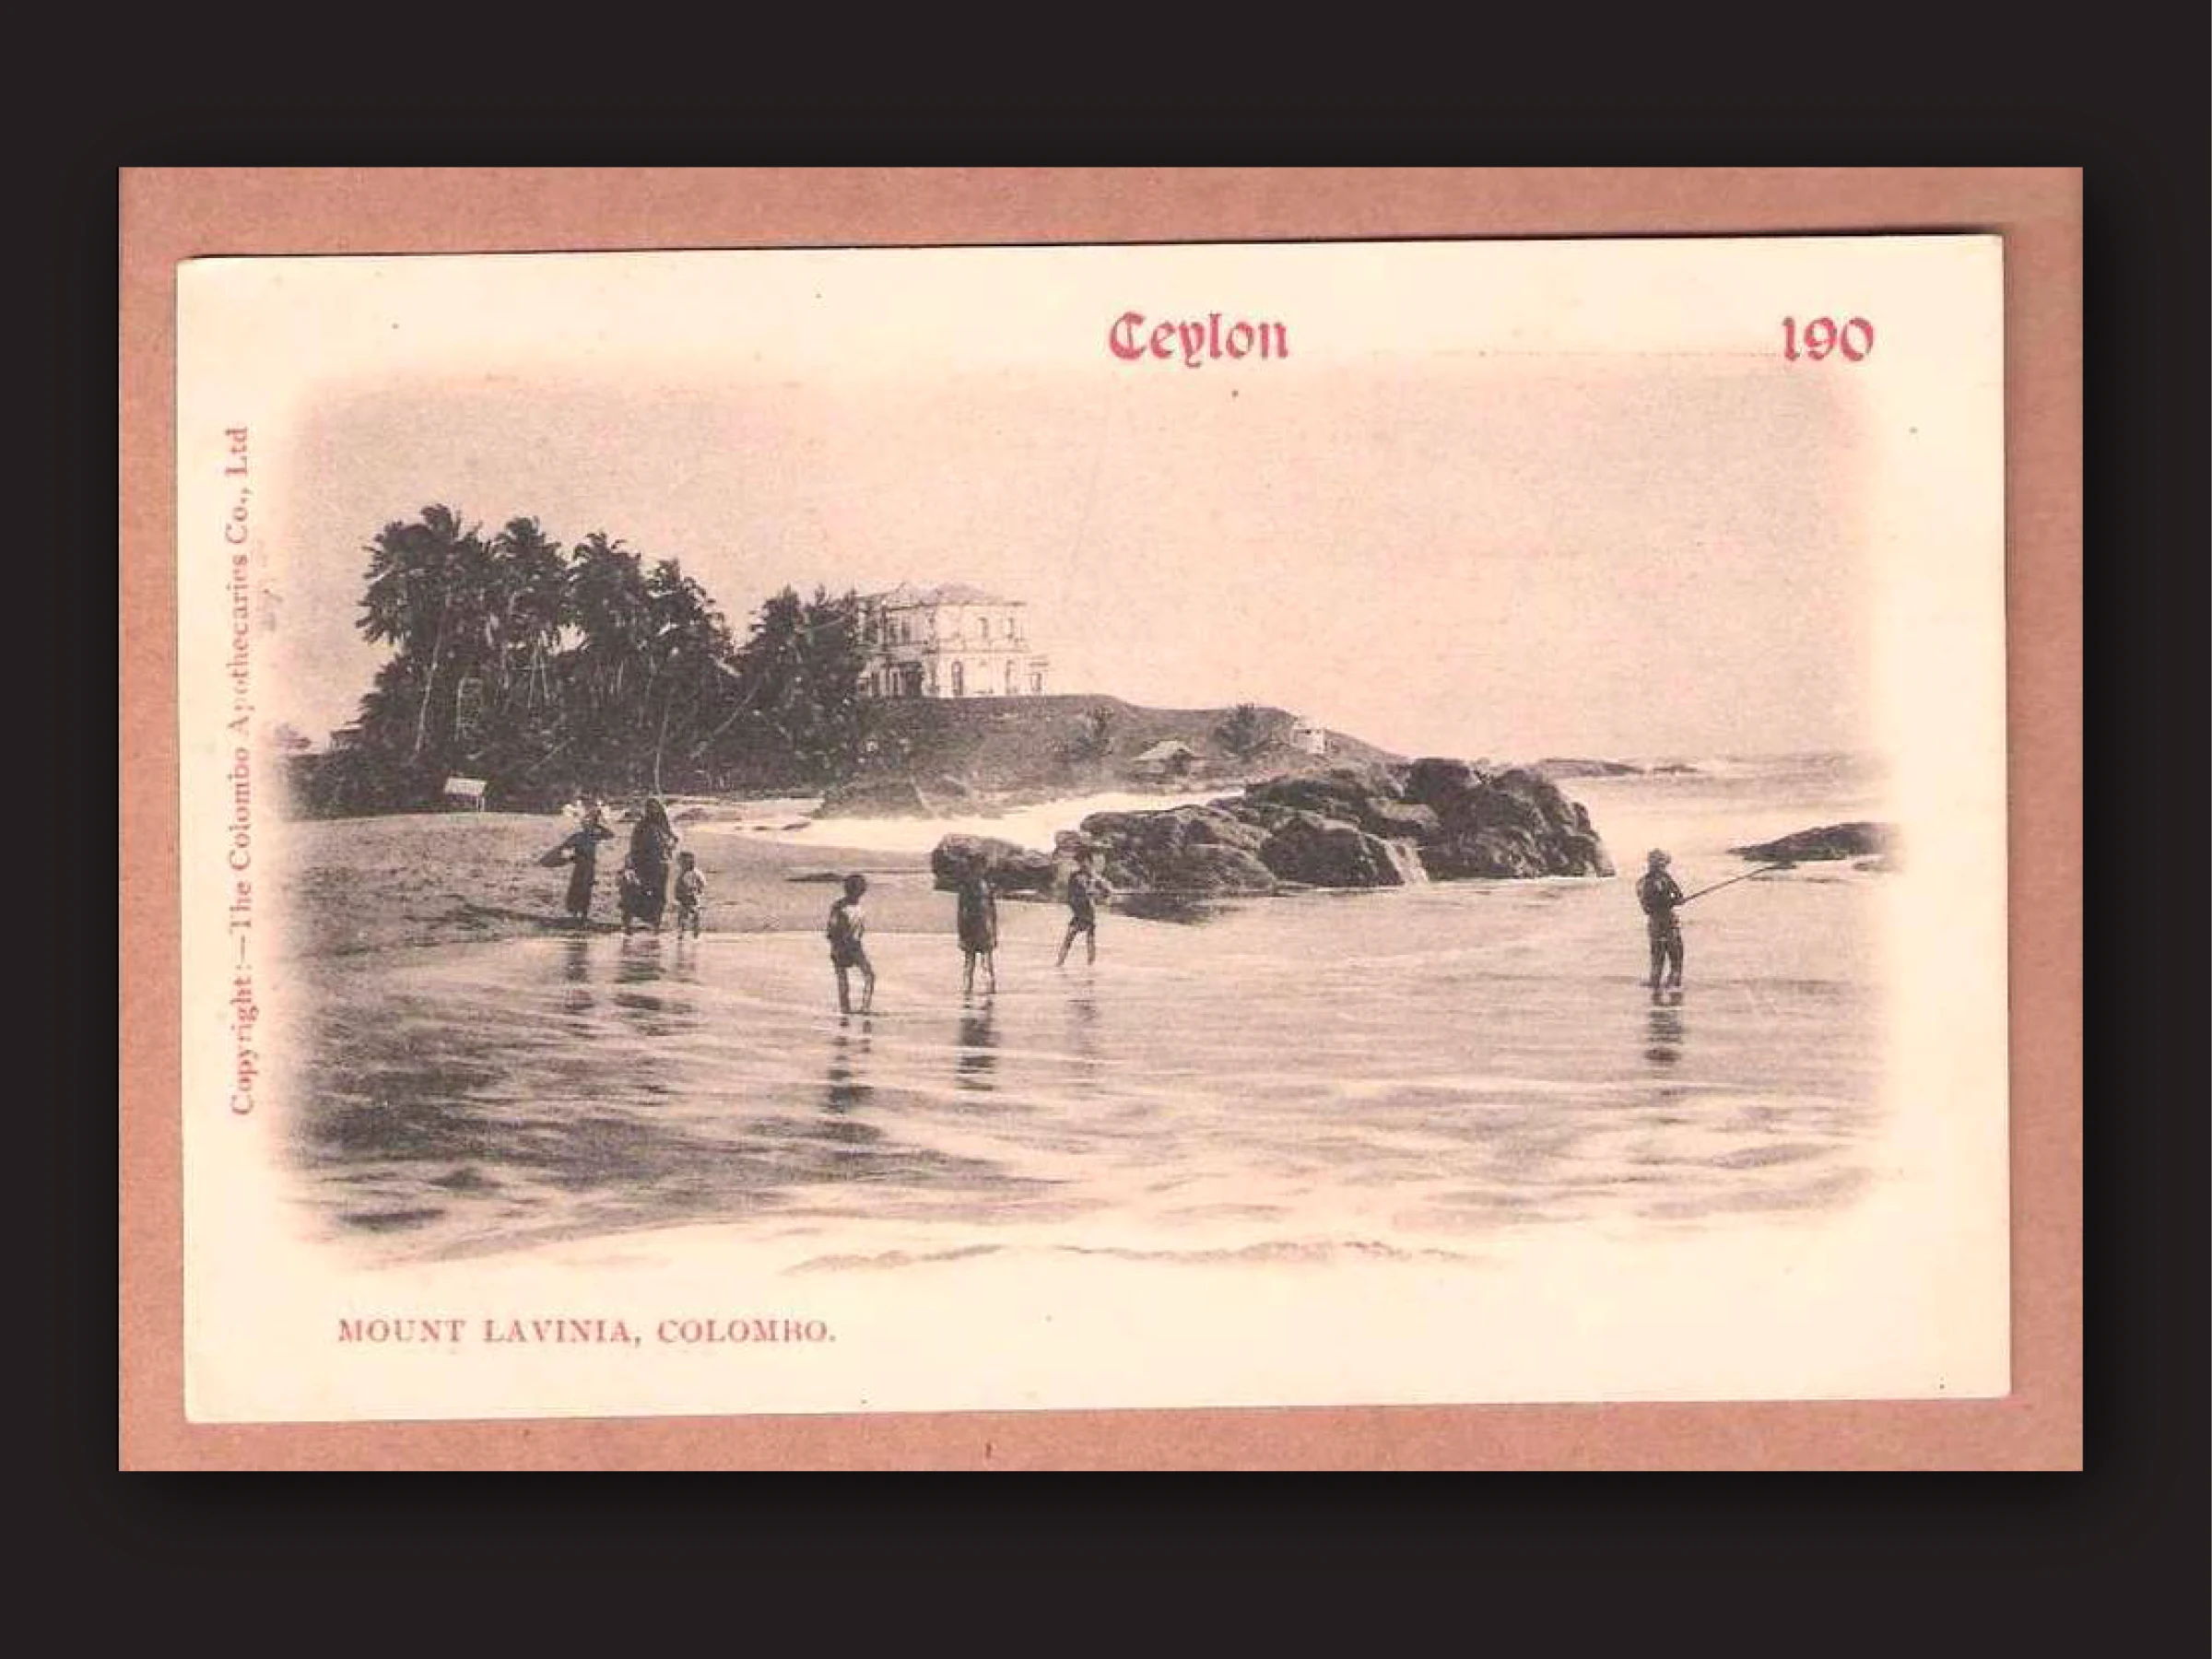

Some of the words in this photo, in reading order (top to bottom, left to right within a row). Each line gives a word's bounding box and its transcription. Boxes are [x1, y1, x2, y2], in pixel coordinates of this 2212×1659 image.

[1109, 312, 1289, 367] Ceylon
[1782, 315, 1875, 363] 190
[224, 426, 249, 477] Ltd
[225, 487, 253, 546] Co.,
[226, 554, 255, 735] Apothecaries
[227, 747, 252, 872] Colombo
[229, 975, 259, 1116] Copyright
[337, 1318, 466, 1344] MOUNT
[483, 1317, 642, 1348] LAVINIA,
[656, 1318, 837, 1344] COLOMBO.
